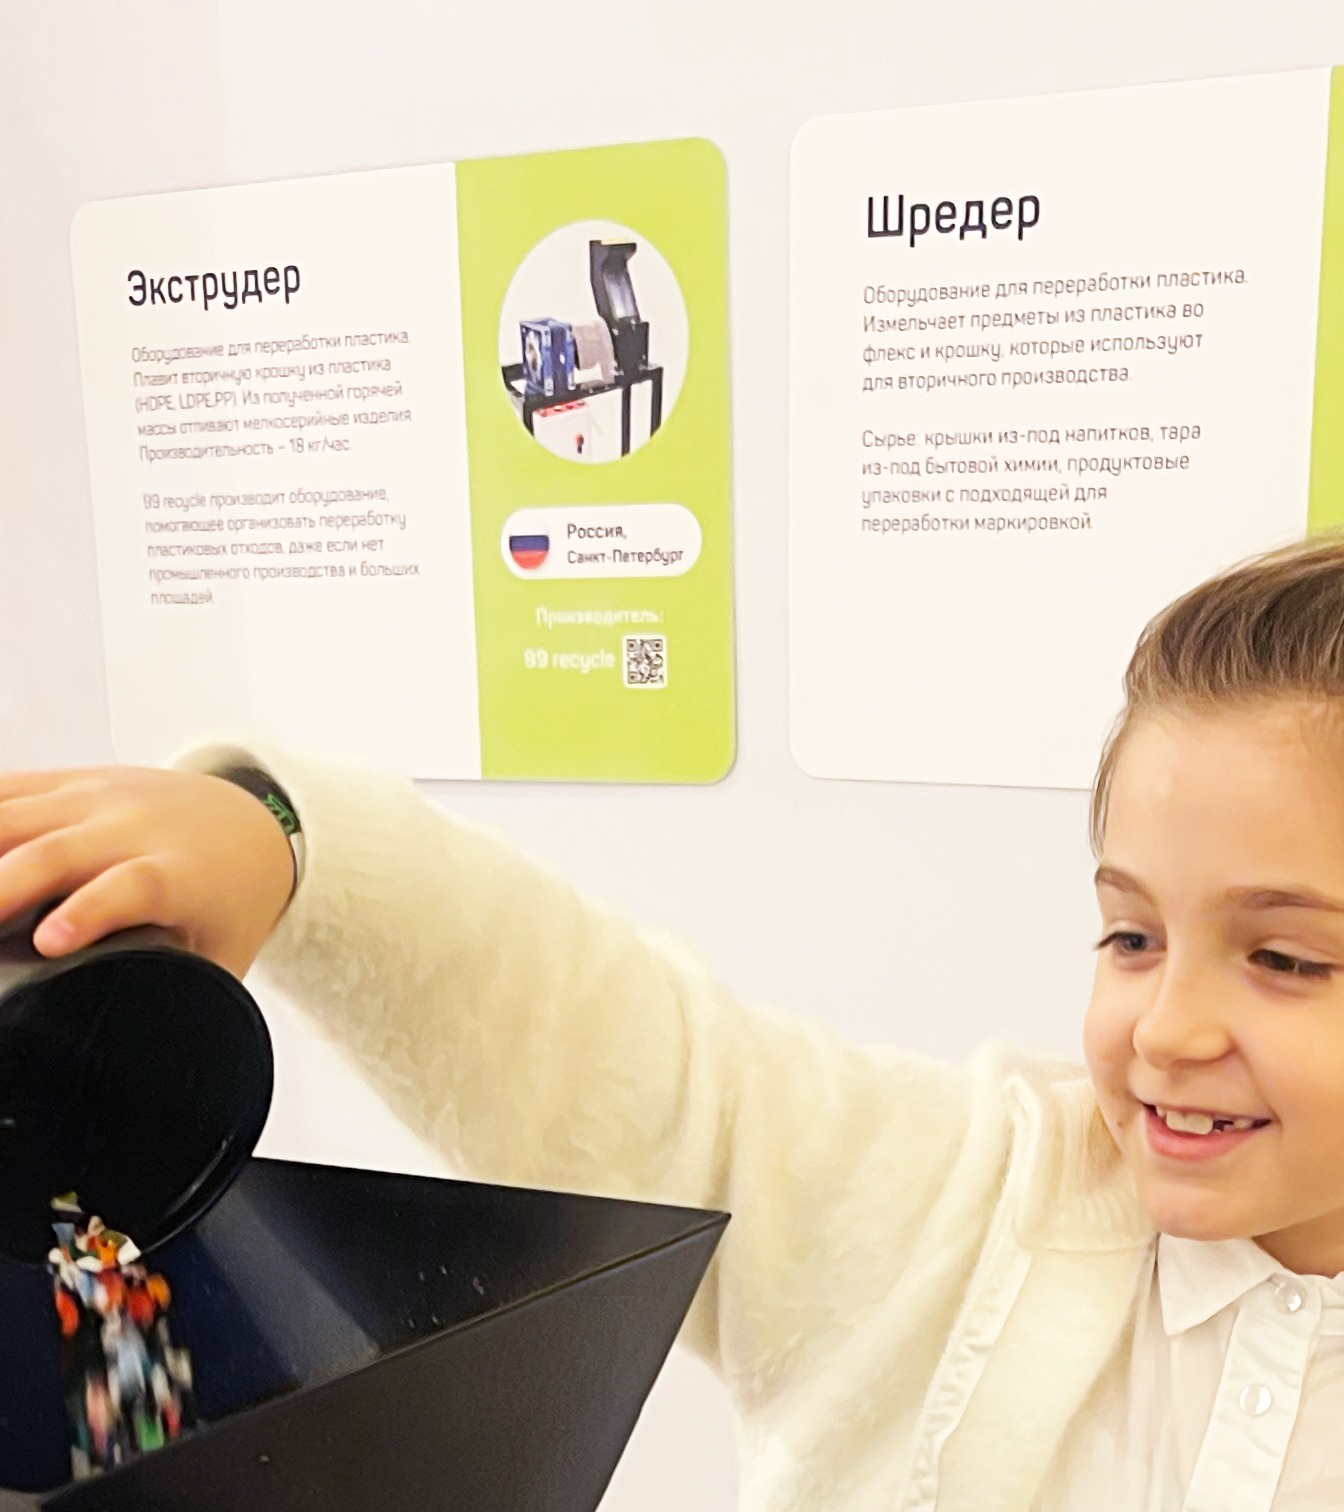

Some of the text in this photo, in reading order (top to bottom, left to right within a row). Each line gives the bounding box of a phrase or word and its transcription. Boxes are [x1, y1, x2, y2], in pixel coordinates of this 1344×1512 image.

[867, 194, 1040, 248] Шредер
[127, 265, 301, 311] Экструдер
[863, 284, 990, 307] Оборудование
[995, 282, 1028, 299] для
[1033, 272, 1151, 298] переработки
[863, 303, 1203, 333] Измельчает предметы из пластика во
[131, 344, 224, 365] Оборудование
[228, 343, 251, 357] для
[255, 334, 341, 356] переработки
[863, 345, 916, 366] флекс
[920, 346, 930, 359] и
[1010, 339, 1085, 359] которые
[1090, 334, 1203, 354] используют
[133, 371, 178, 387] Плавит
[256, 366, 305, 382] крошку
[308, 363, 325, 375] из
[328, 358, 391, 374] пластика
[862, 376, 893, 392] для
[898, 372, 996, 392] вторичного
[263, 384, 344, 407] полученной
[347, 381, 403, 401] горячей
[925, 431, 993, 449] крышки
[998, 429, 1060, 445] из-под
[1065, 427, 1154, 442] напитков,
[1159, 425, 1201, 443] тара
[140, 443, 274, 464] Производительность
[289, 437, 304, 453] 18
[862, 455, 1190, 477] из-под бытовой химии, продуктовые
[861, 483, 1107, 509] упаковки с подходящей для
[227, 517, 316, 533] организовать
[319, 510, 406, 532] переработку
[567, 523, 627, 540] Россия,
[862, 513, 970, 535] переработки
[327, 540, 357, 552] если
[361, 539, 384, 551] нет
[567, 547, 684, 566] Санкт-Петербург
[253, 566, 345, 581] производства
[348, 566, 357, 577] и
[360, 561, 420, 576] больших
[552, 648, 615, 674] recycle
